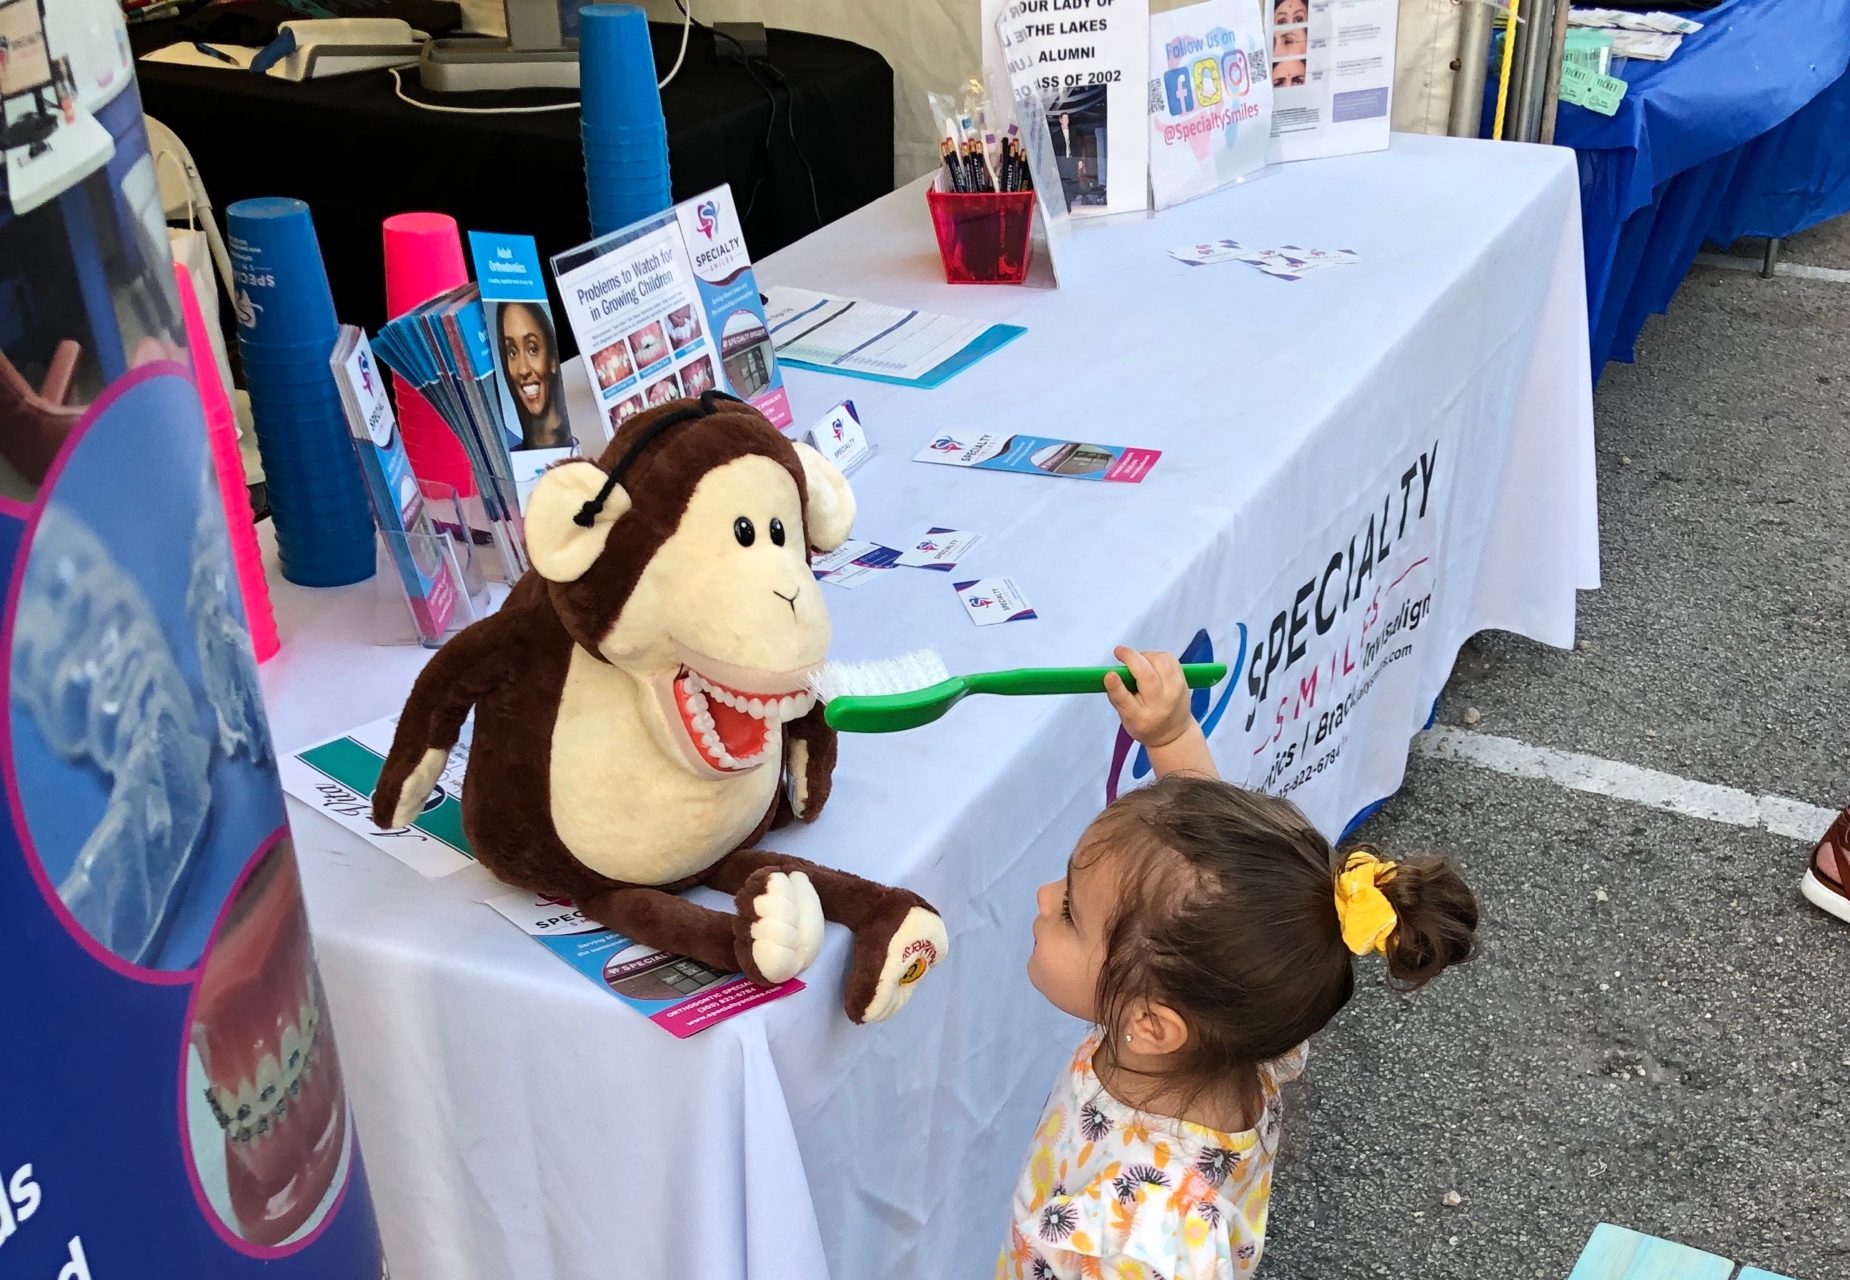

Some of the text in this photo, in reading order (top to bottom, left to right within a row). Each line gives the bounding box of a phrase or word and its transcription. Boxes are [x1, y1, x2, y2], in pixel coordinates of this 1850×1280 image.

[1053, 0, 1090, 11] LADY
[1026, 19, 1107, 37] THE LAKES
[1038, 46, 1095, 63] ALUMNI
[1166, 30, 1235, 60] Follow us on
[1064, 74, 1083, 87] OF
[1088, 70, 1121, 85] 2002
[1597, 78, 1618, 93] TICKET
[1164, 103, 1259, 146] @SpecialtySmiles
[696, 237, 740, 267] SPECIALTY
[577, 248, 673, 305] Problems to Watch for
[589, 306, 601, 322] in
[601, 286, 640, 316] Growing
[637, 270, 674, 297] Children
[961, 434, 992, 462] SPECIALTY
[1245, 439, 1438, 732] SPECIALTY
[1272, 585, 1382, 743] SMILES
[1279, 751, 1341, 798] 5-822-6784
[536, 910, 584, 929] SPEC
[666, 979, 753, 1018] ORTHODONTIC SPECIAL
[686, 985, 783, 1026] www.specialtysmiles.com
[696, 987, 755, 1014] (305) 822-6784
